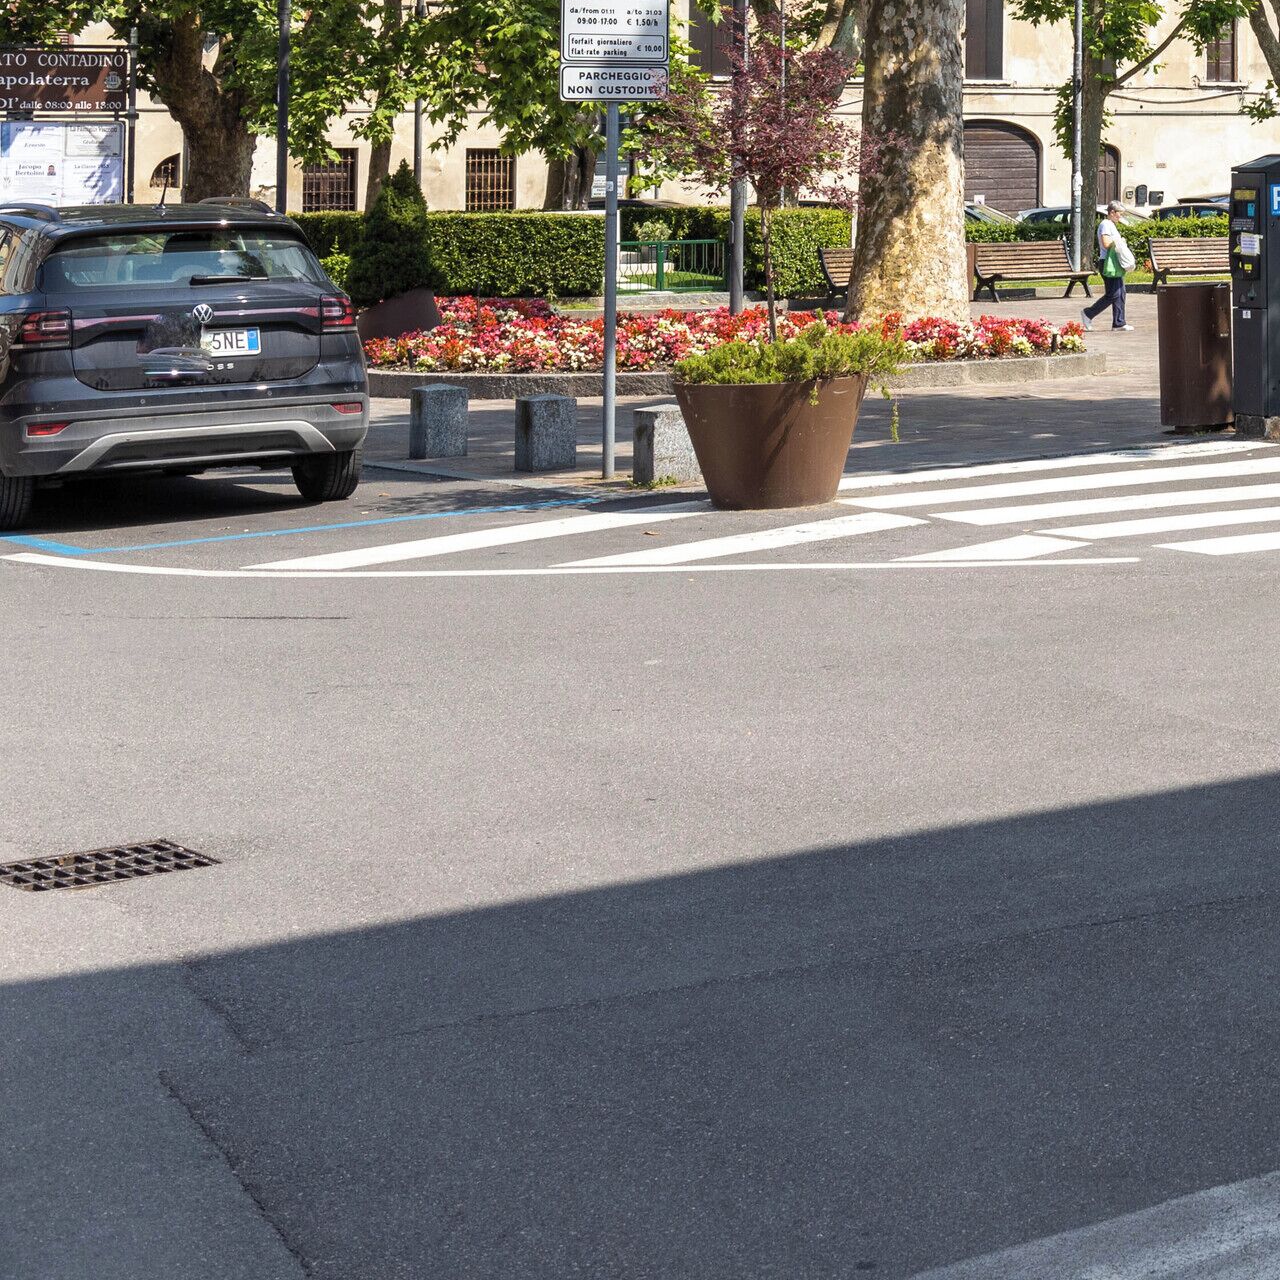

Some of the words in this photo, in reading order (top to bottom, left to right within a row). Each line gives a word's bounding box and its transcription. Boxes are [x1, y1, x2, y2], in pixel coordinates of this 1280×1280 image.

[636, 18, 658, 26] 1,50/h
[0, 53, 27, 66] TO
[38, 54, 124, 67] CONTADINO
[579, 72, 651, 80] PARCHEGGIO
[568, 86, 592, 94] NON
[20, 101, 42, 109] dalle
[75, 101, 92, 109] alle
